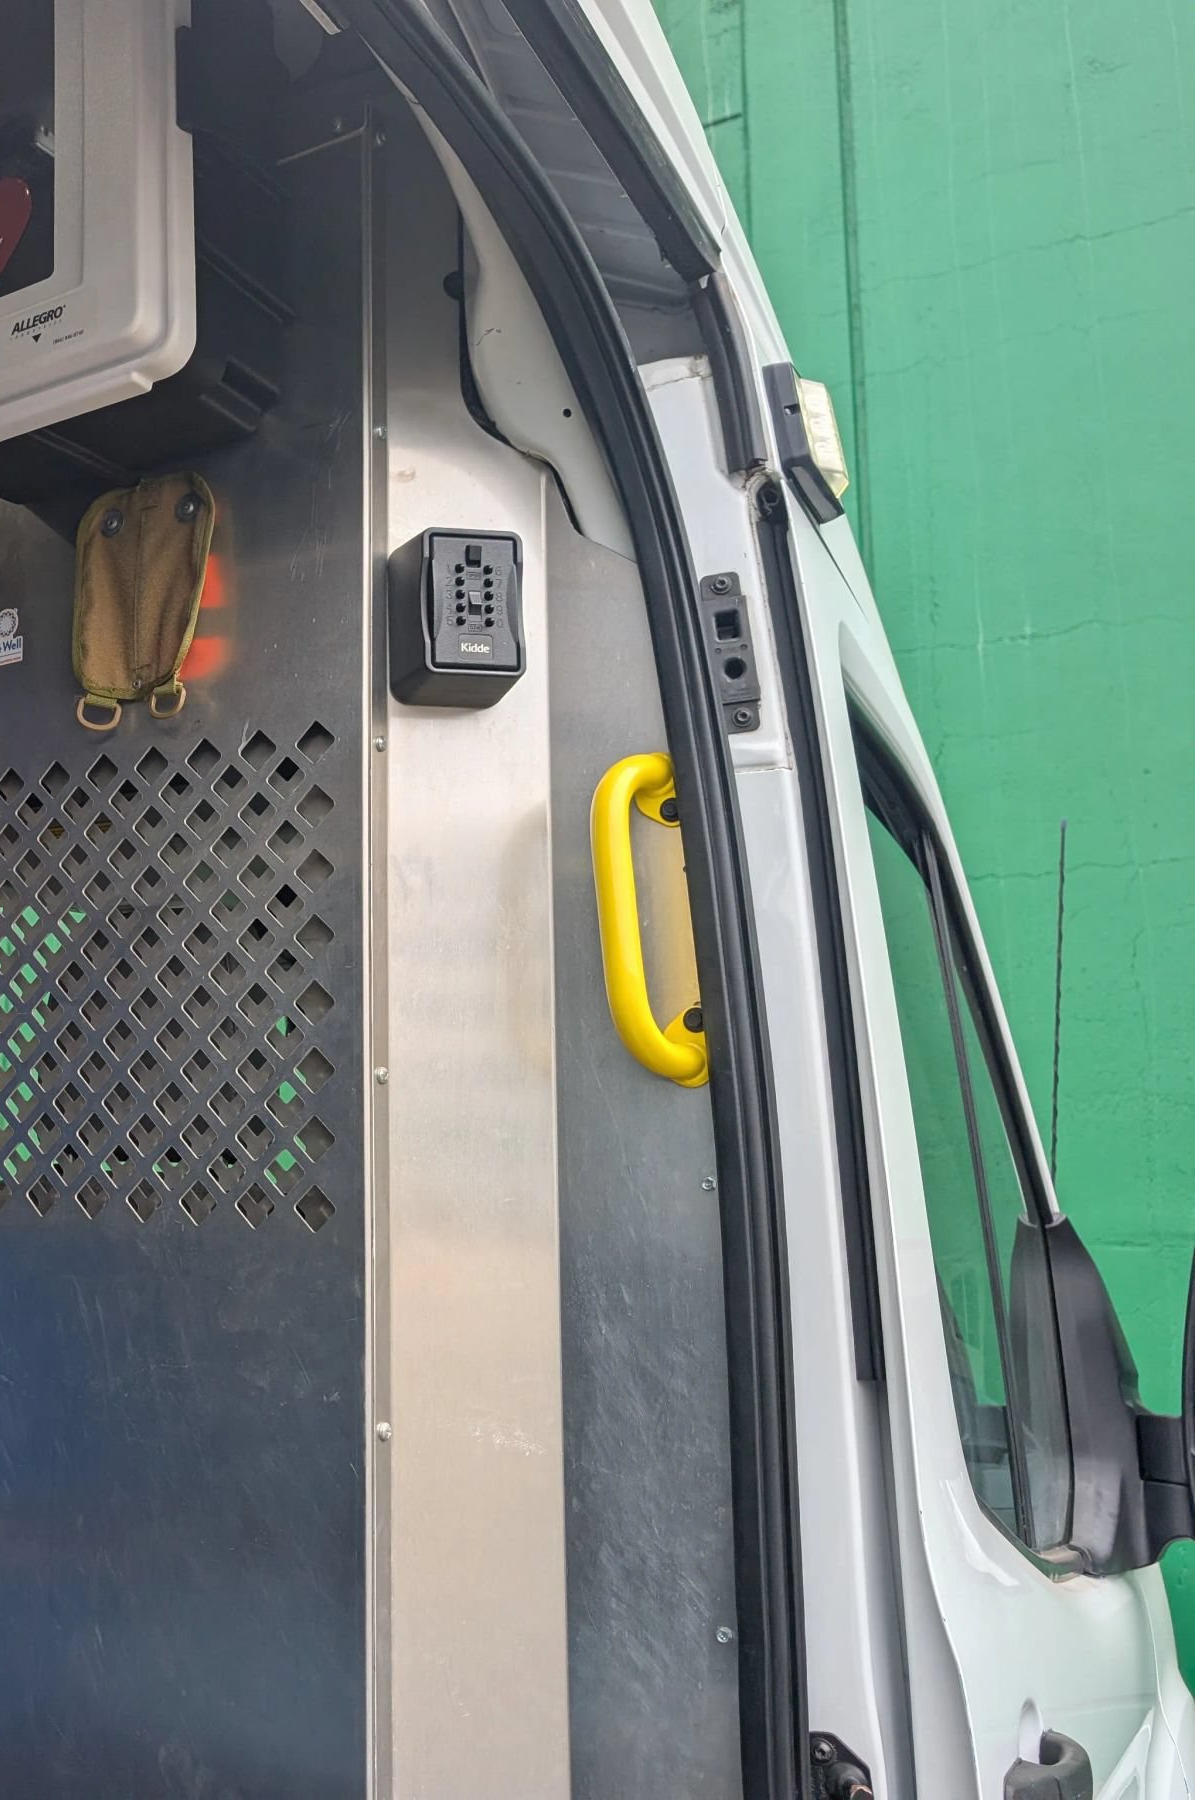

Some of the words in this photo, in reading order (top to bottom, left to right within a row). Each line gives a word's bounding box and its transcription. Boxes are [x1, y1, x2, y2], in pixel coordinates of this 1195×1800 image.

[11, 306, 64, 335] ALLEGRO
[3, 638, 21, 651] Well
[460, 642, 491, 654] Kidde
